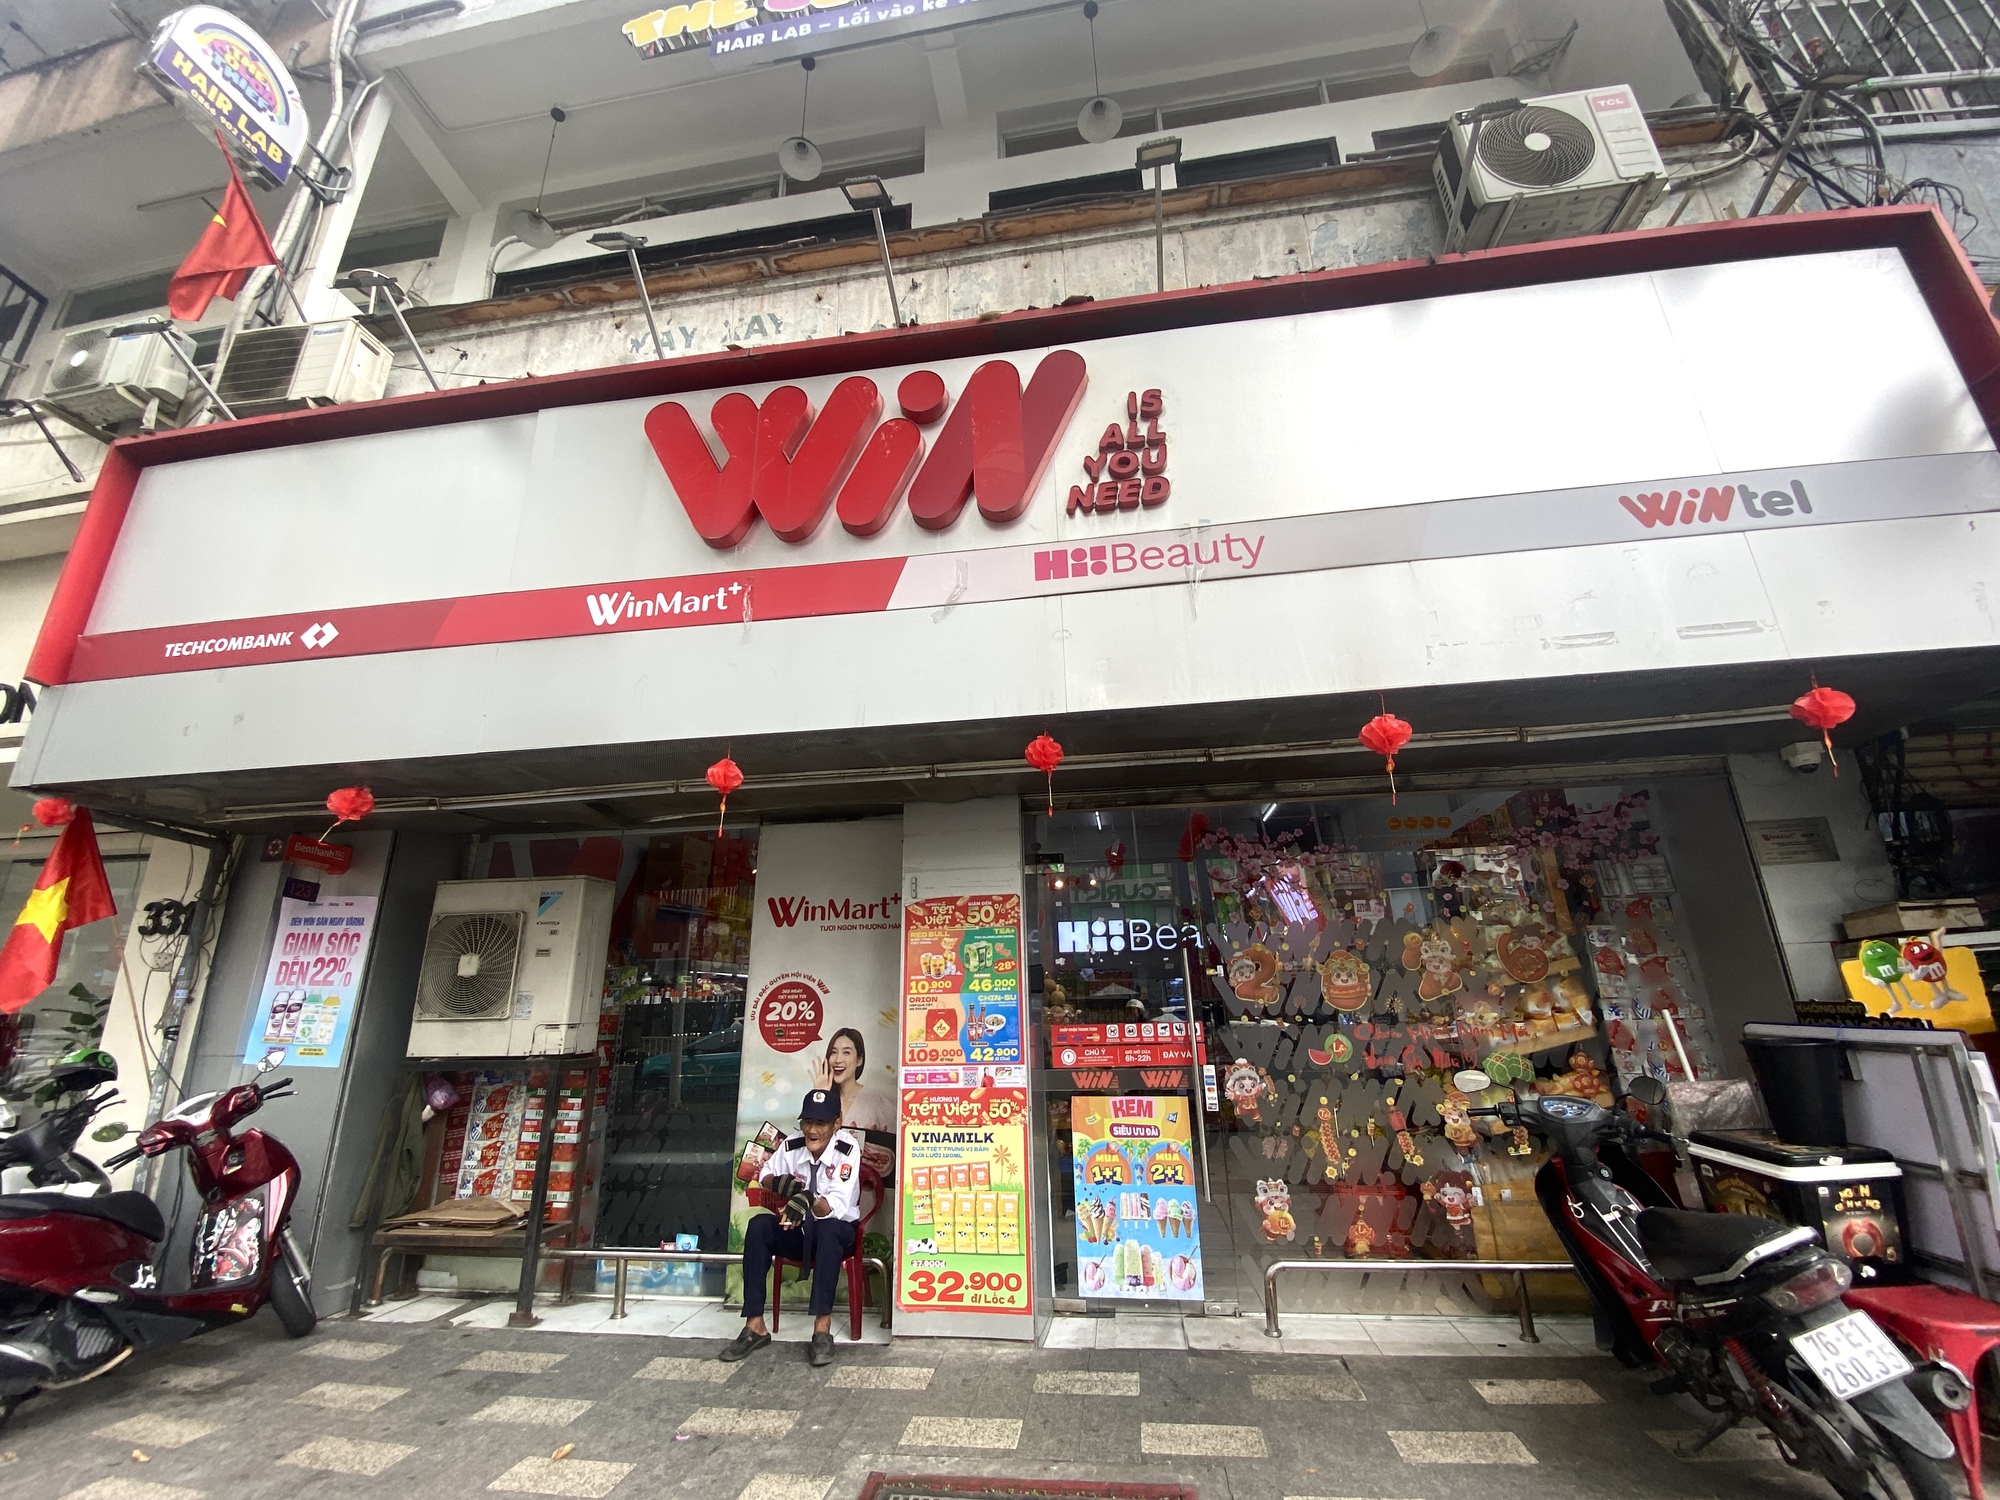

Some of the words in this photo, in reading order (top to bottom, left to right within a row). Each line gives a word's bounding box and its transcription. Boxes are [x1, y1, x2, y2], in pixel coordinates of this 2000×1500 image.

[715, 33, 765, 54] HAIR
[771, 22, 812, 44] LAB
[876, 4, 915, 21] vào
[172, 50, 233, 116] HAIR
[237, 113, 284, 164] LAB
[1597, 98, 1625, 107] TCL
[241, 135, 258, 154] 120
[1128, 388, 1163, 420] IS
[1099, 417, 1168, 452] ALL
[1084, 444, 1168, 482] YOU
[1066, 475, 1172, 515] NEED
[164, 630, 294, 658] TECHCOMBANK
[967, 903, 1006, 924] 50%
[282, 927, 324, 956] GIẢM
[308, 957, 352, 988] 22%
[909, 981, 952, 994] 10.900
[969, 979, 1016, 992] 46.000
[978, 994, 1017, 1002] CHIN-SU
[765, 1000, 815, 1021] 20%
[908, 1049, 963, 1062] 109.000
[970, 1048, 1018, 1061] 42.900
[1084, 1047, 1099, 1056] CHÚ
[1101, 1047, 1106, 1055] Ý
[989, 1102, 1020, 1118] 50%
[1111, 1099, 1154, 1118] KEM
[911, 1132, 994, 1143] VINAMILK
[1113, 1125, 1131, 1136] SIÊU
[1132, 1127, 1144, 1136] ƯU
[1095, 1154, 1119, 1162] MUA
[1155, 1153, 1180, 1161] MUA
[1091, 1165, 1123, 1183] 1+1
[1150, 1163, 1184, 1183] 2+1
[908, 1270, 1022, 1302] 32.900
[1007, 1295, 1016, 1305] 4
[1804, 1319, 1873, 1361] 76-E1
[1822, 1344, 1904, 1397] 260.35
